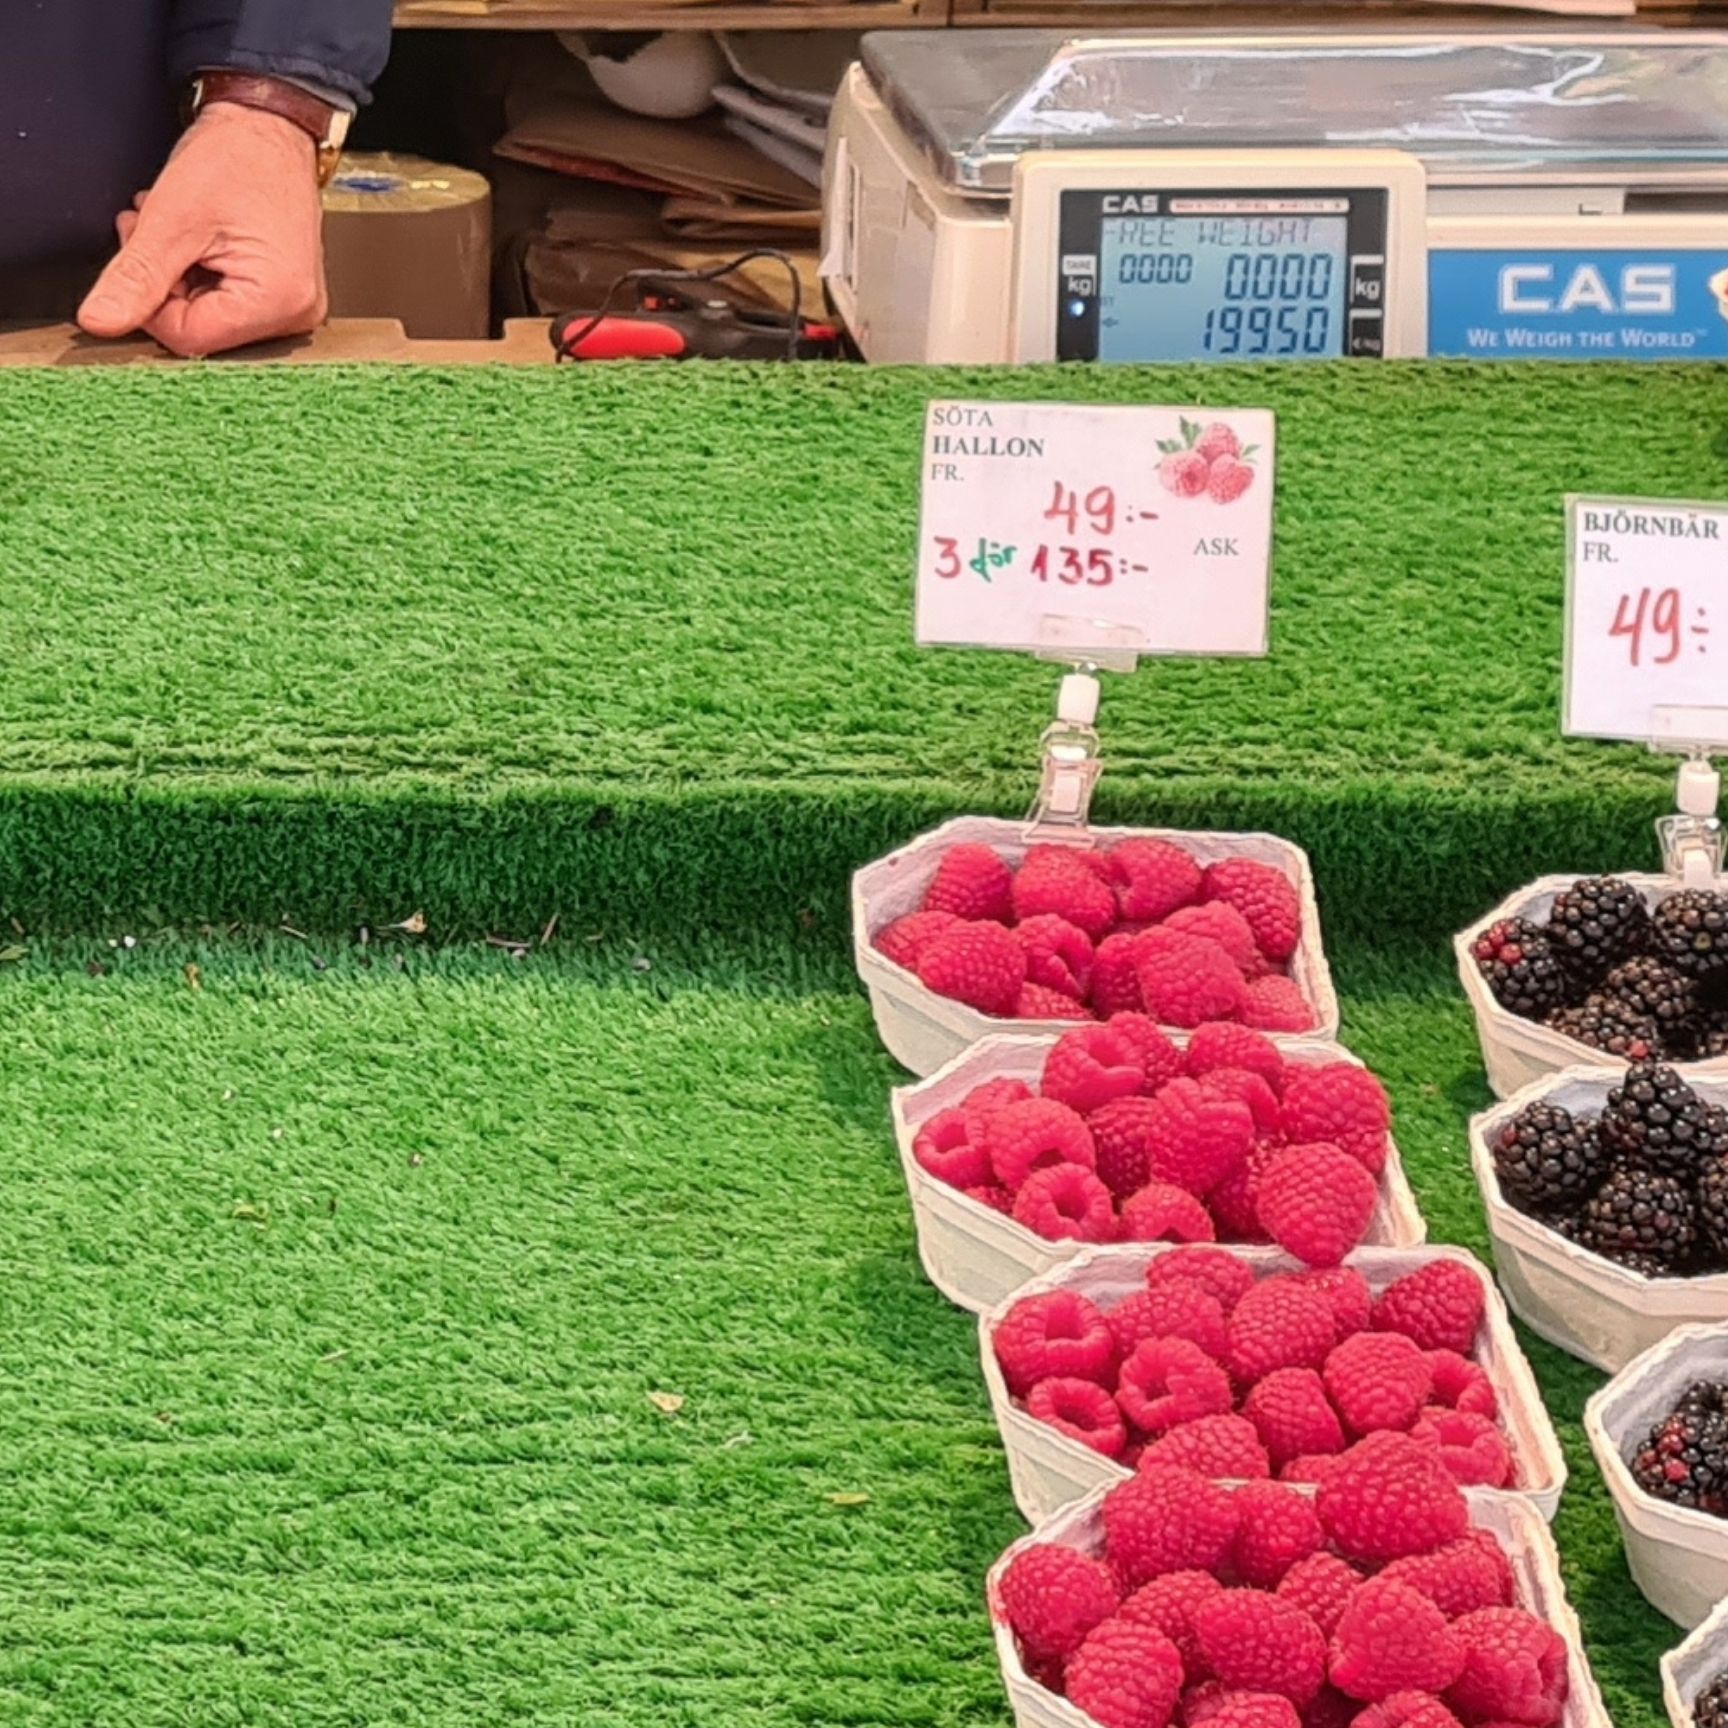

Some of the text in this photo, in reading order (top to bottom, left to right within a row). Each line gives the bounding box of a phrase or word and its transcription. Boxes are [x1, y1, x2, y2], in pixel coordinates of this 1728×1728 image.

[1102, 195, 1159, 213] CAS
[1067, 276, 1093, 296] kg
[1355, 276, 1381, 300] kg
[1499, 263, 1677, 314] CAS
[932, 405, 994, 427] SÖTA
[932, 435, 1045, 457] HALLON
[930, 463, 965, 482] FR.
[1044, 480, 1160, 535] 49:-
[1583, 509, 1720, 540] BJÖRNBÄR
[1193, 536, 1241, 557] ASK
[1582, 541, 1620, 563] FR.
[932, 535, 962, 580] 3
[1030, 544, 1150, 587] 135:-
